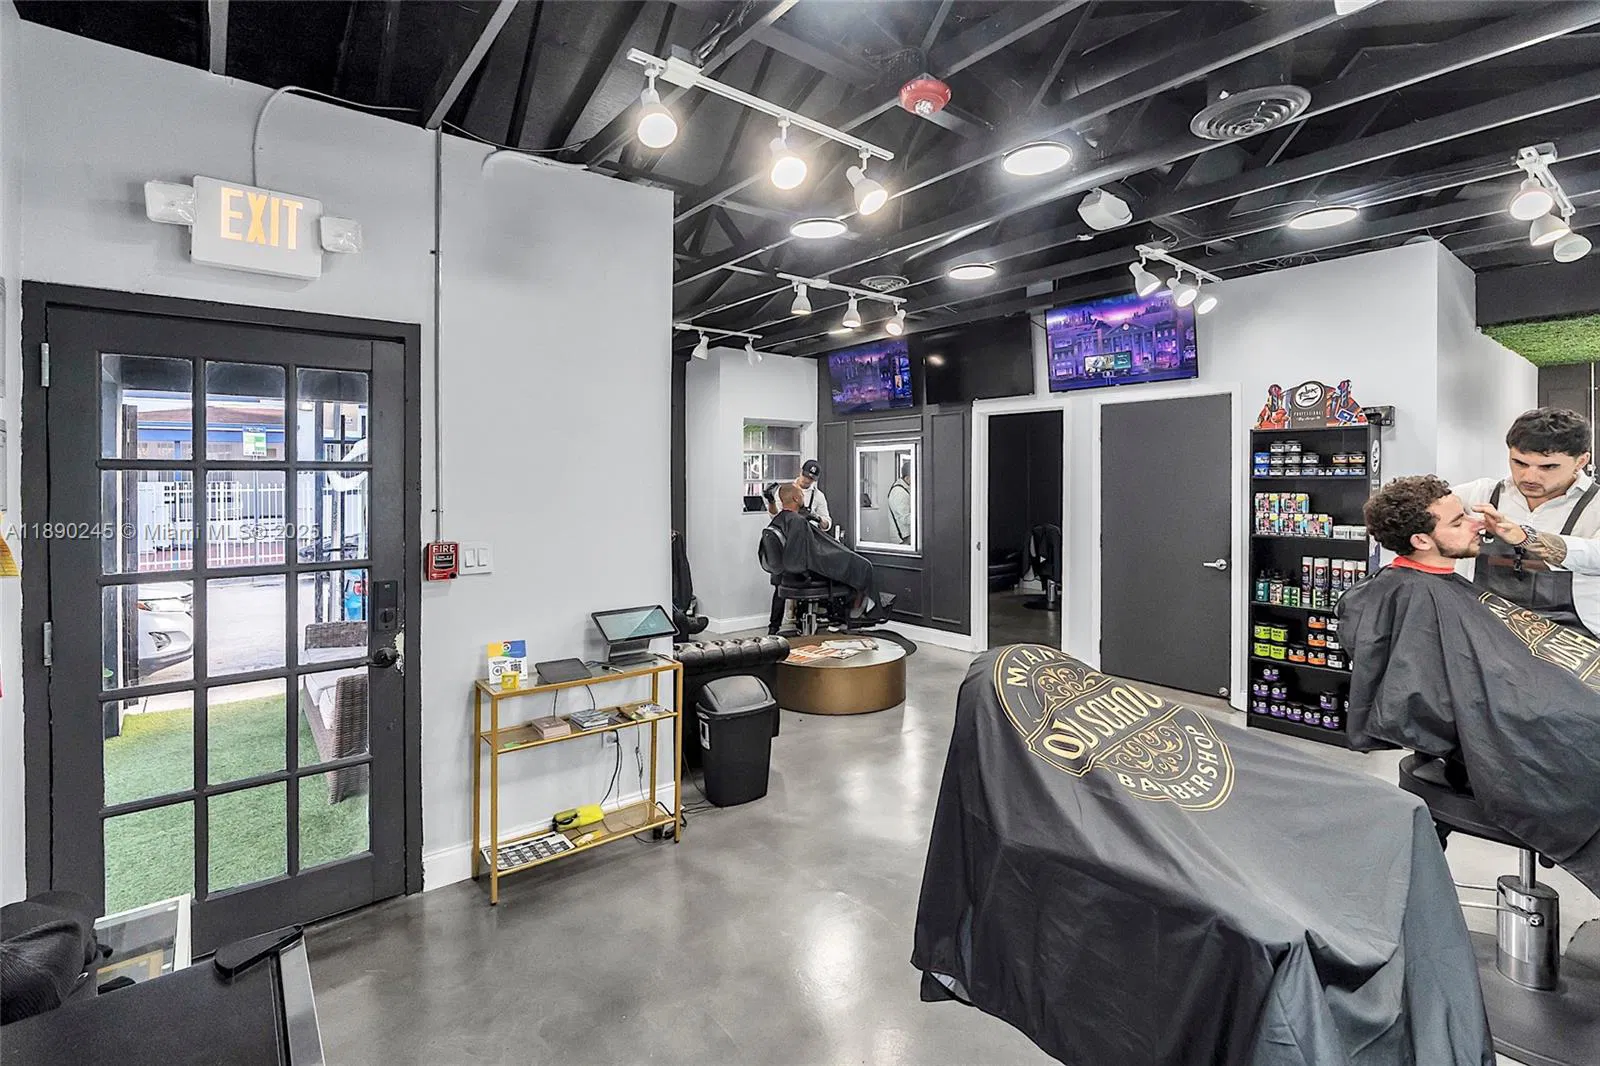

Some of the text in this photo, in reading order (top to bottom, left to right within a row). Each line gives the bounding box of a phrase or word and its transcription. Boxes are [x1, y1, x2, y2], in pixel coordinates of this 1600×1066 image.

[220, 186, 303, 250] EXIT
[432, 544, 456, 553] FIRE
[1116, 725, 1219, 800] BARBERSHOP
